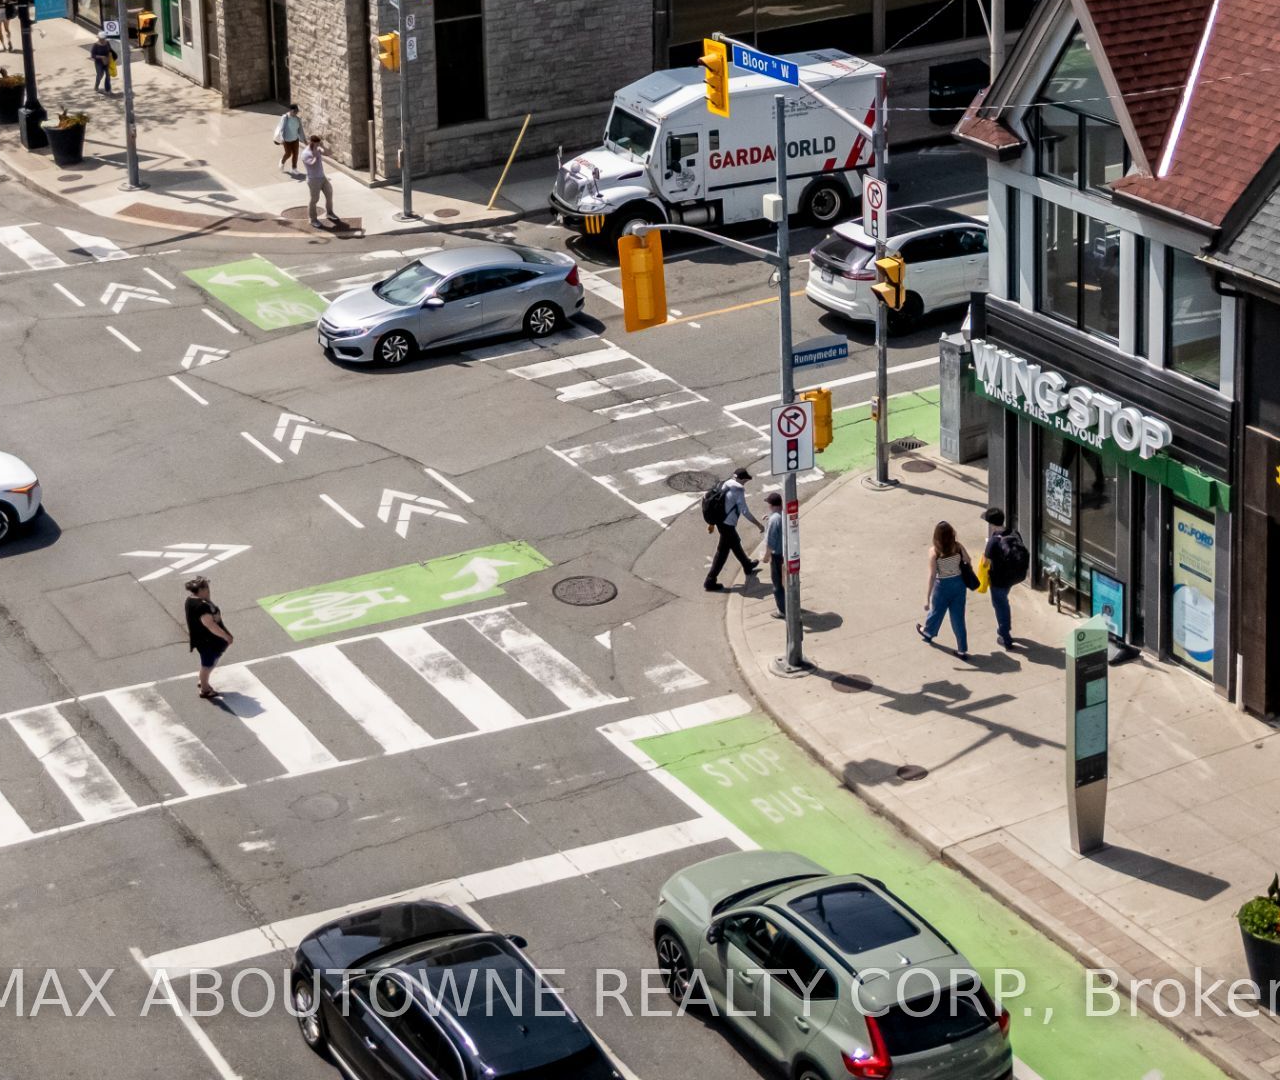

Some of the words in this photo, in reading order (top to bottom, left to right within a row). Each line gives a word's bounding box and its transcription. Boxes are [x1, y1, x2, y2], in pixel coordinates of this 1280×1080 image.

[742, 51, 769, 72] Bloor
[780, 64, 790, 79] W
[709, 135, 836, 170] GARDAORLD
[794, 348, 838, 365] Runnymede
[1055, 414, 1105, 450] FLAVOUR
[702, 748, 785, 788] STOP
[751, 786, 825, 824] BUS
